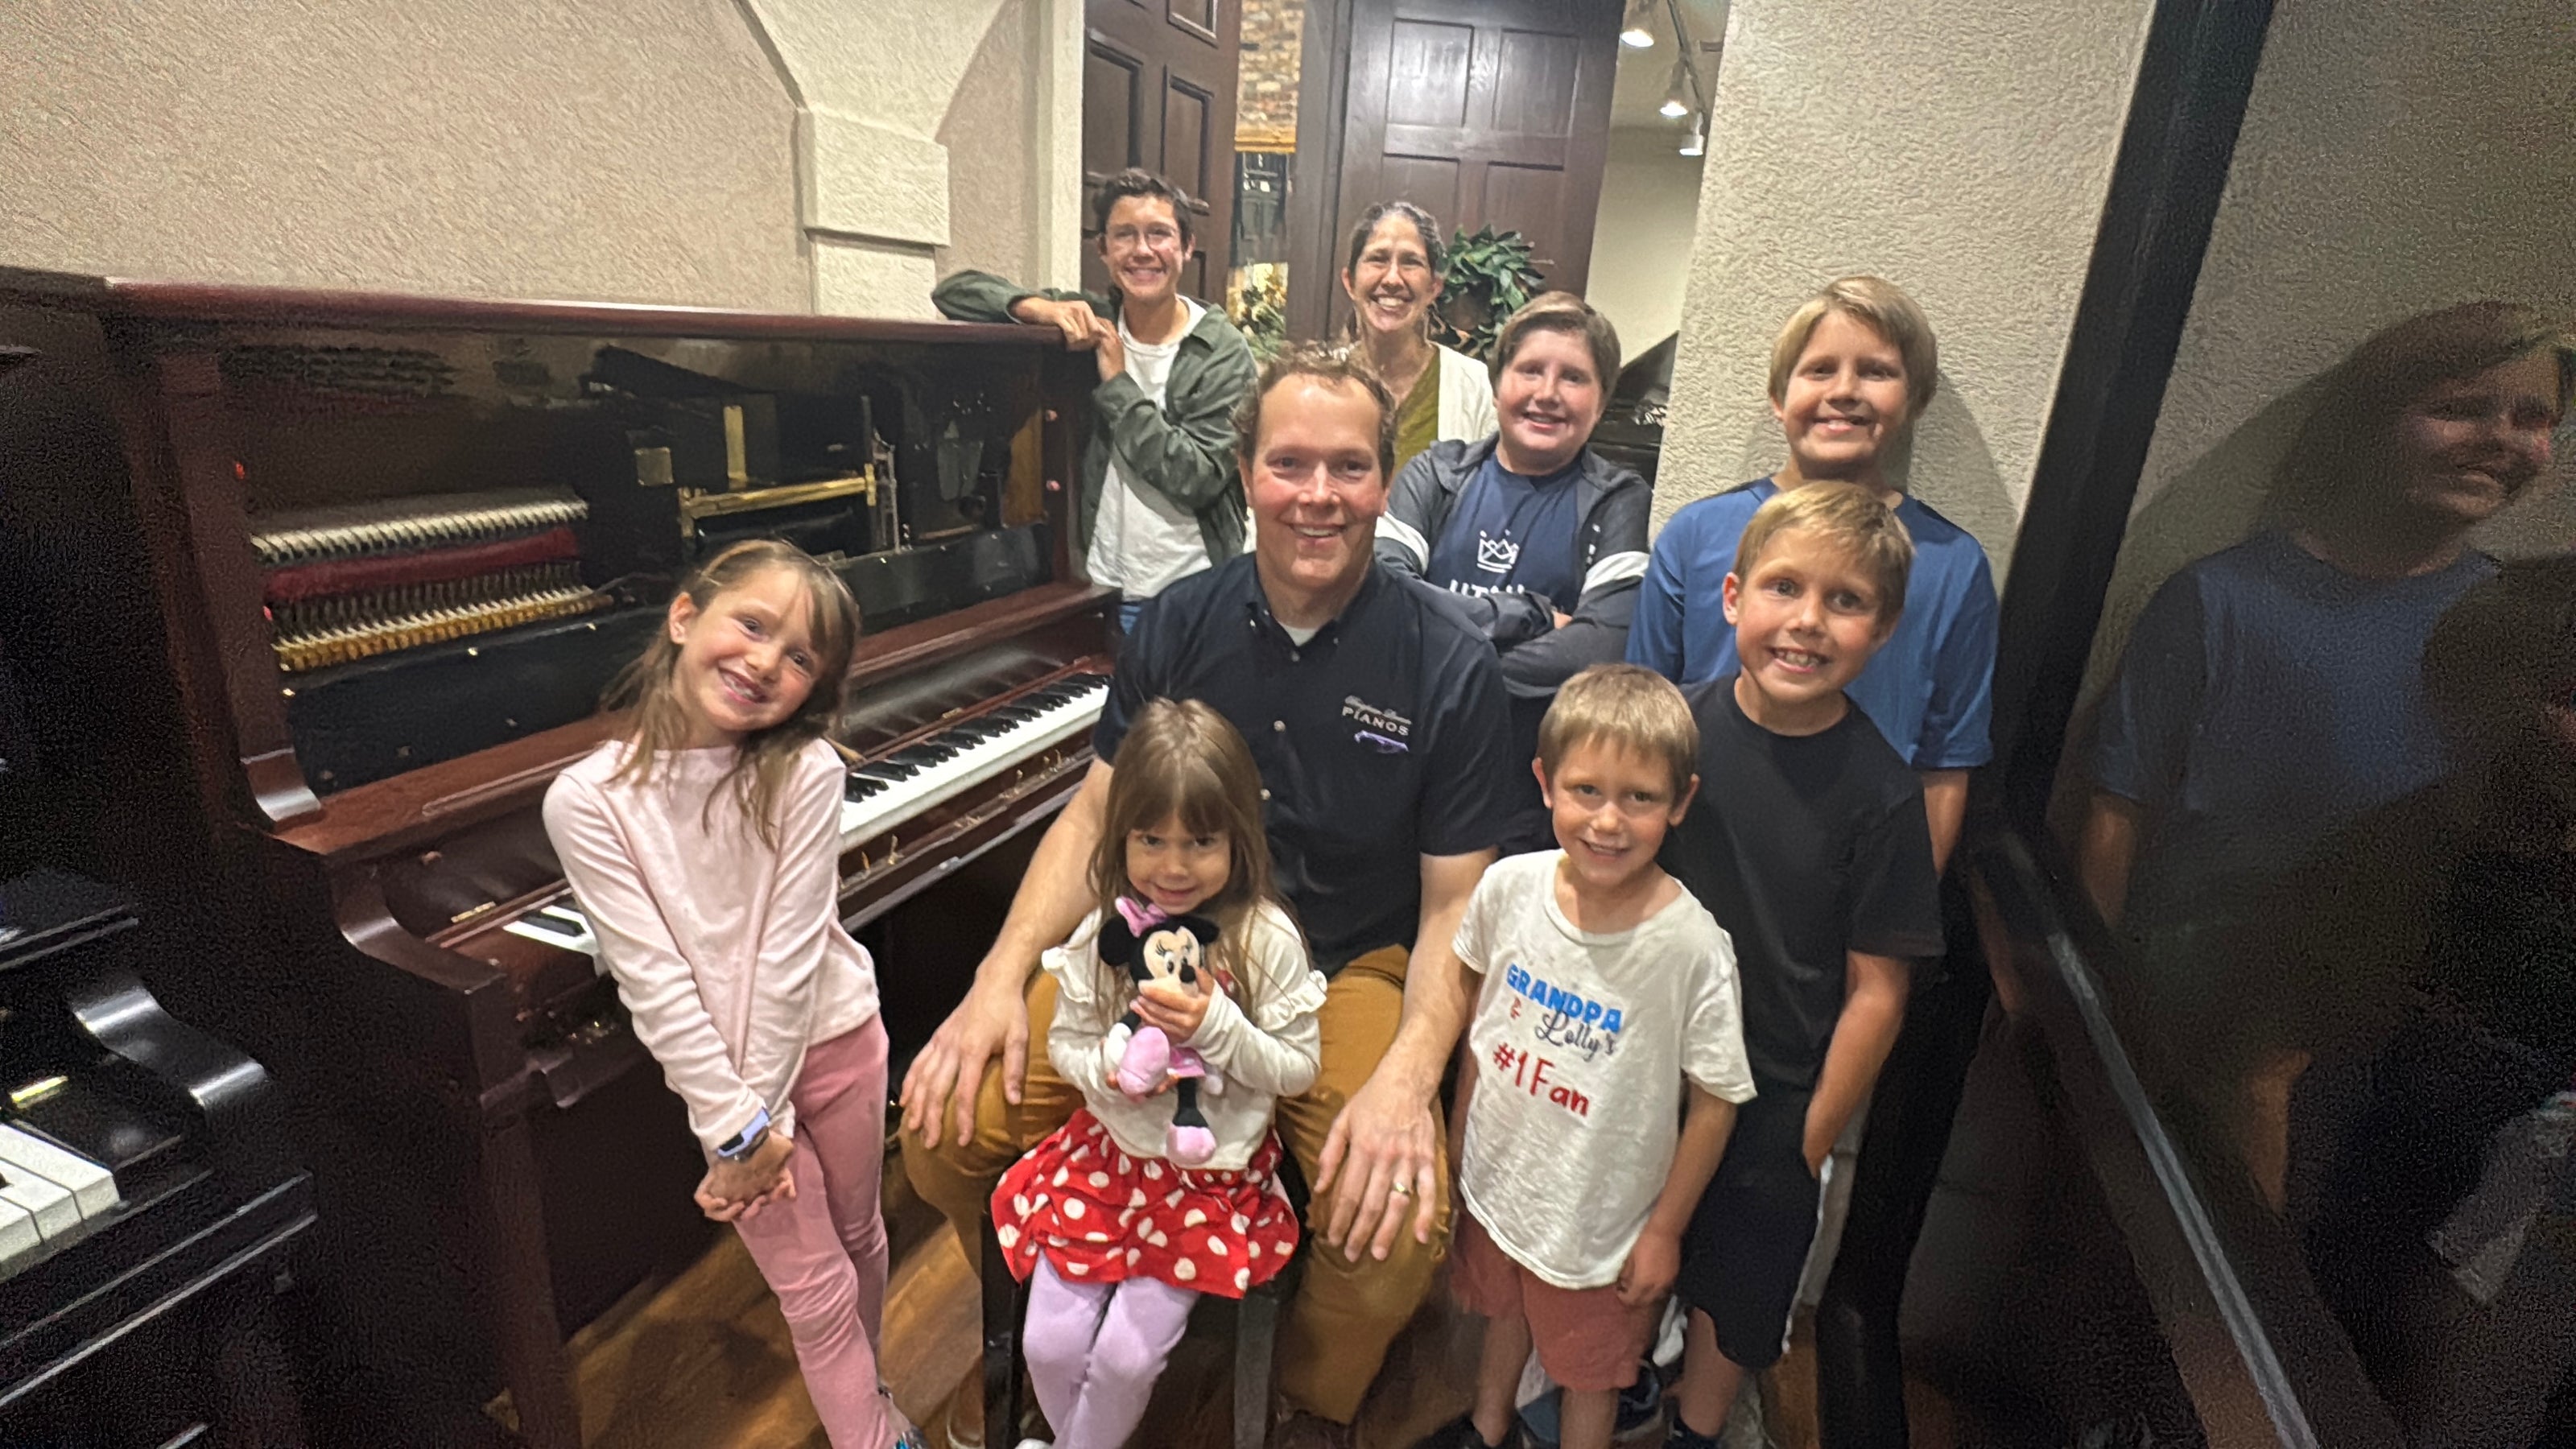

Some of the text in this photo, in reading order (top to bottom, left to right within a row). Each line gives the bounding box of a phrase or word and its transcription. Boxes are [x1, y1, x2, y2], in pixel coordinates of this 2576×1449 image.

[1342, 706, 1409, 736] PIANOS
[1507, 963, 1621, 1034] GRANDPA
[1530, 1057, 1589, 1117] Fan
